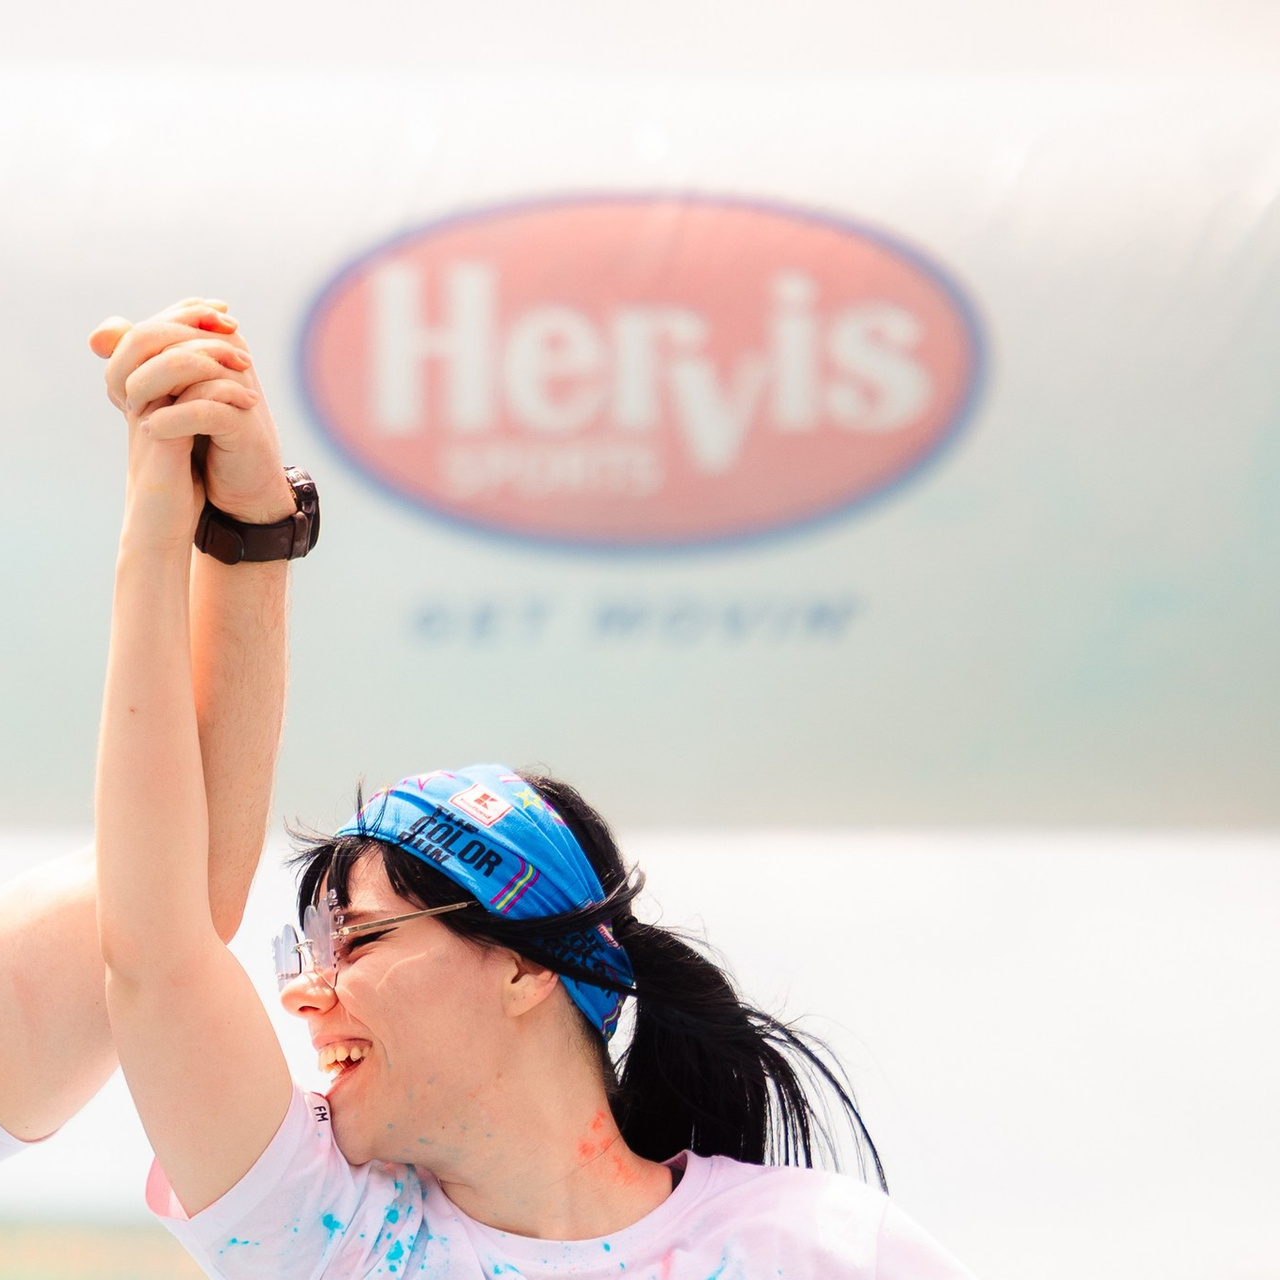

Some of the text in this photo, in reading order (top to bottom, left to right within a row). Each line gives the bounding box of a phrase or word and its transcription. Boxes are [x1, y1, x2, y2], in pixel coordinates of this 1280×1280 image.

[370, 258, 932, 474] Hervis
[442, 442, 662, 498] SPORTS
[397, 830, 451, 866] RUN
[409, 814, 503, 878] COLOR
